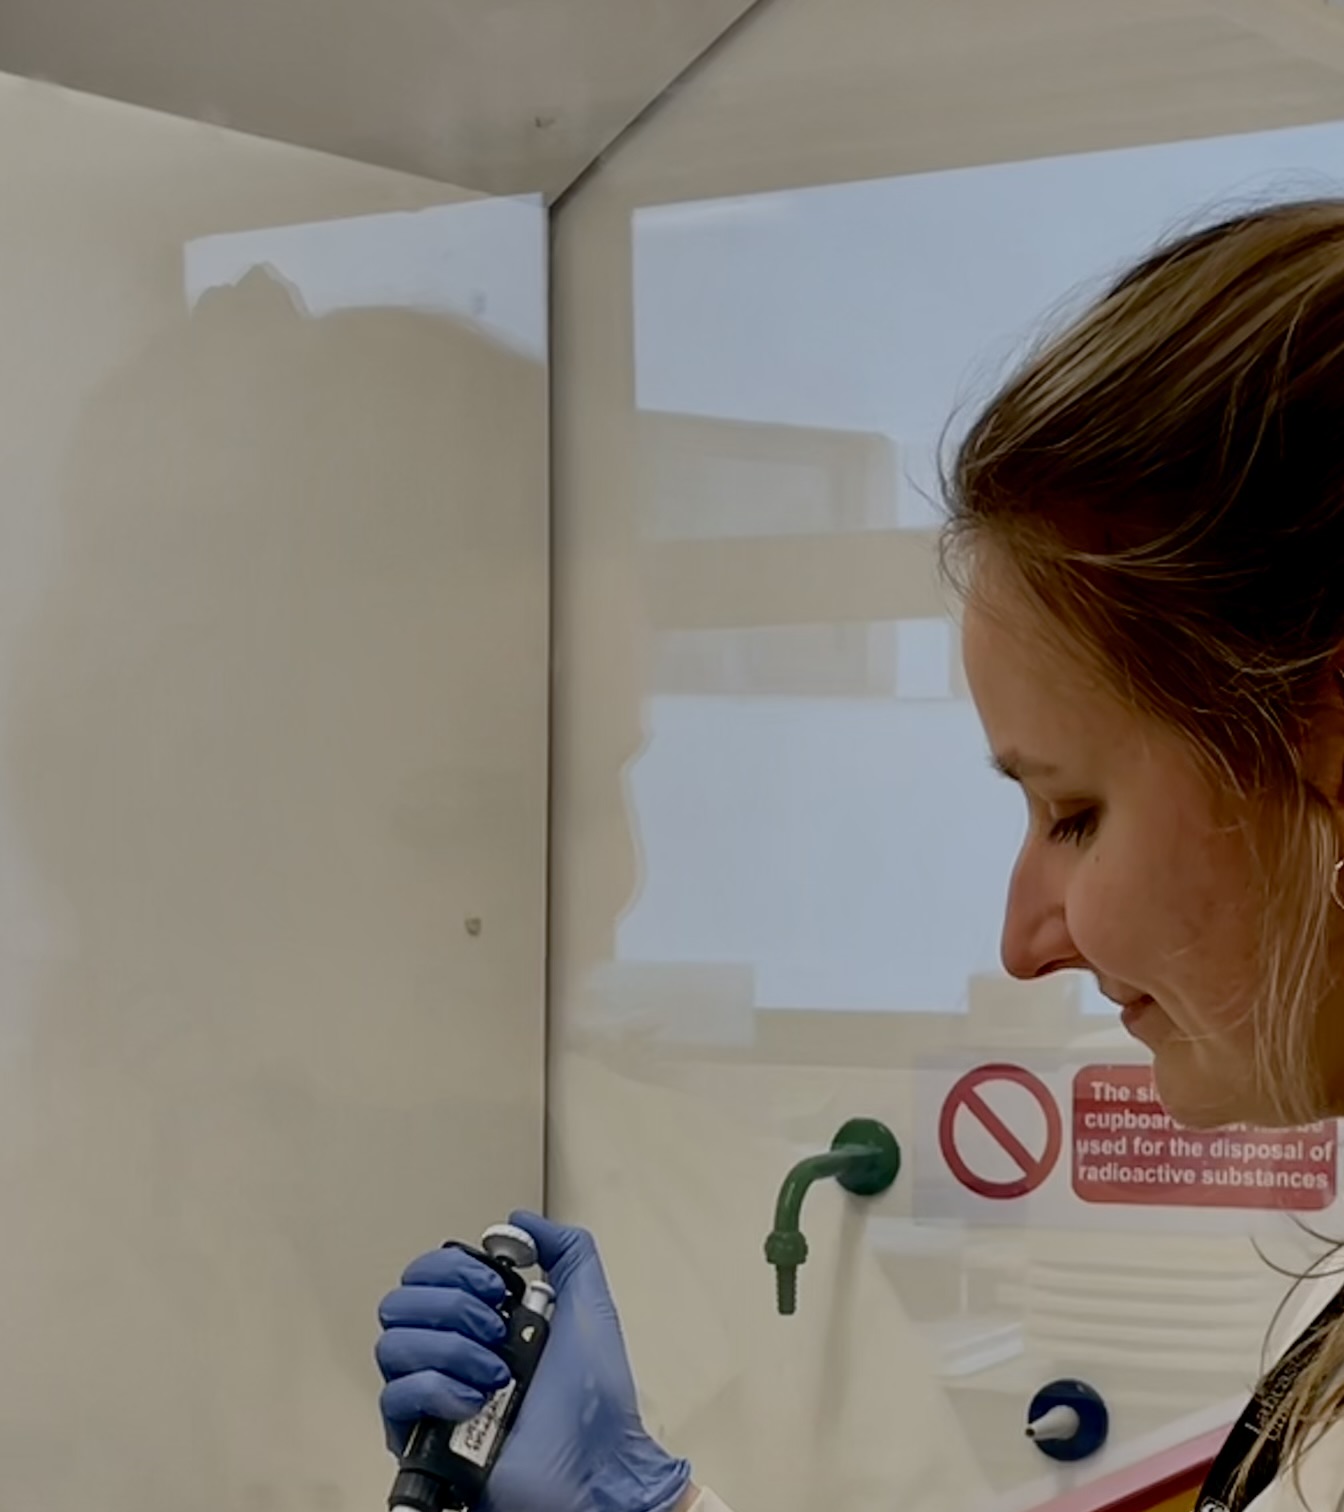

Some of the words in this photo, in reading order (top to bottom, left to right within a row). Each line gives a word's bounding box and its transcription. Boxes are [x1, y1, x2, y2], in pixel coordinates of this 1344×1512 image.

[1091, 1080, 1131, 1103] The
[1076, 1137, 1127, 1158] used
[1133, 1136, 1167, 1158] for
[1169, 1137, 1205, 1158] the
[1209, 1139, 1304, 1164] disposal
[1309, 1140, 1333, 1163] of
[1078, 1162, 1196, 1186] radioactive
[1201, 1166, 1329, 1191] substances
